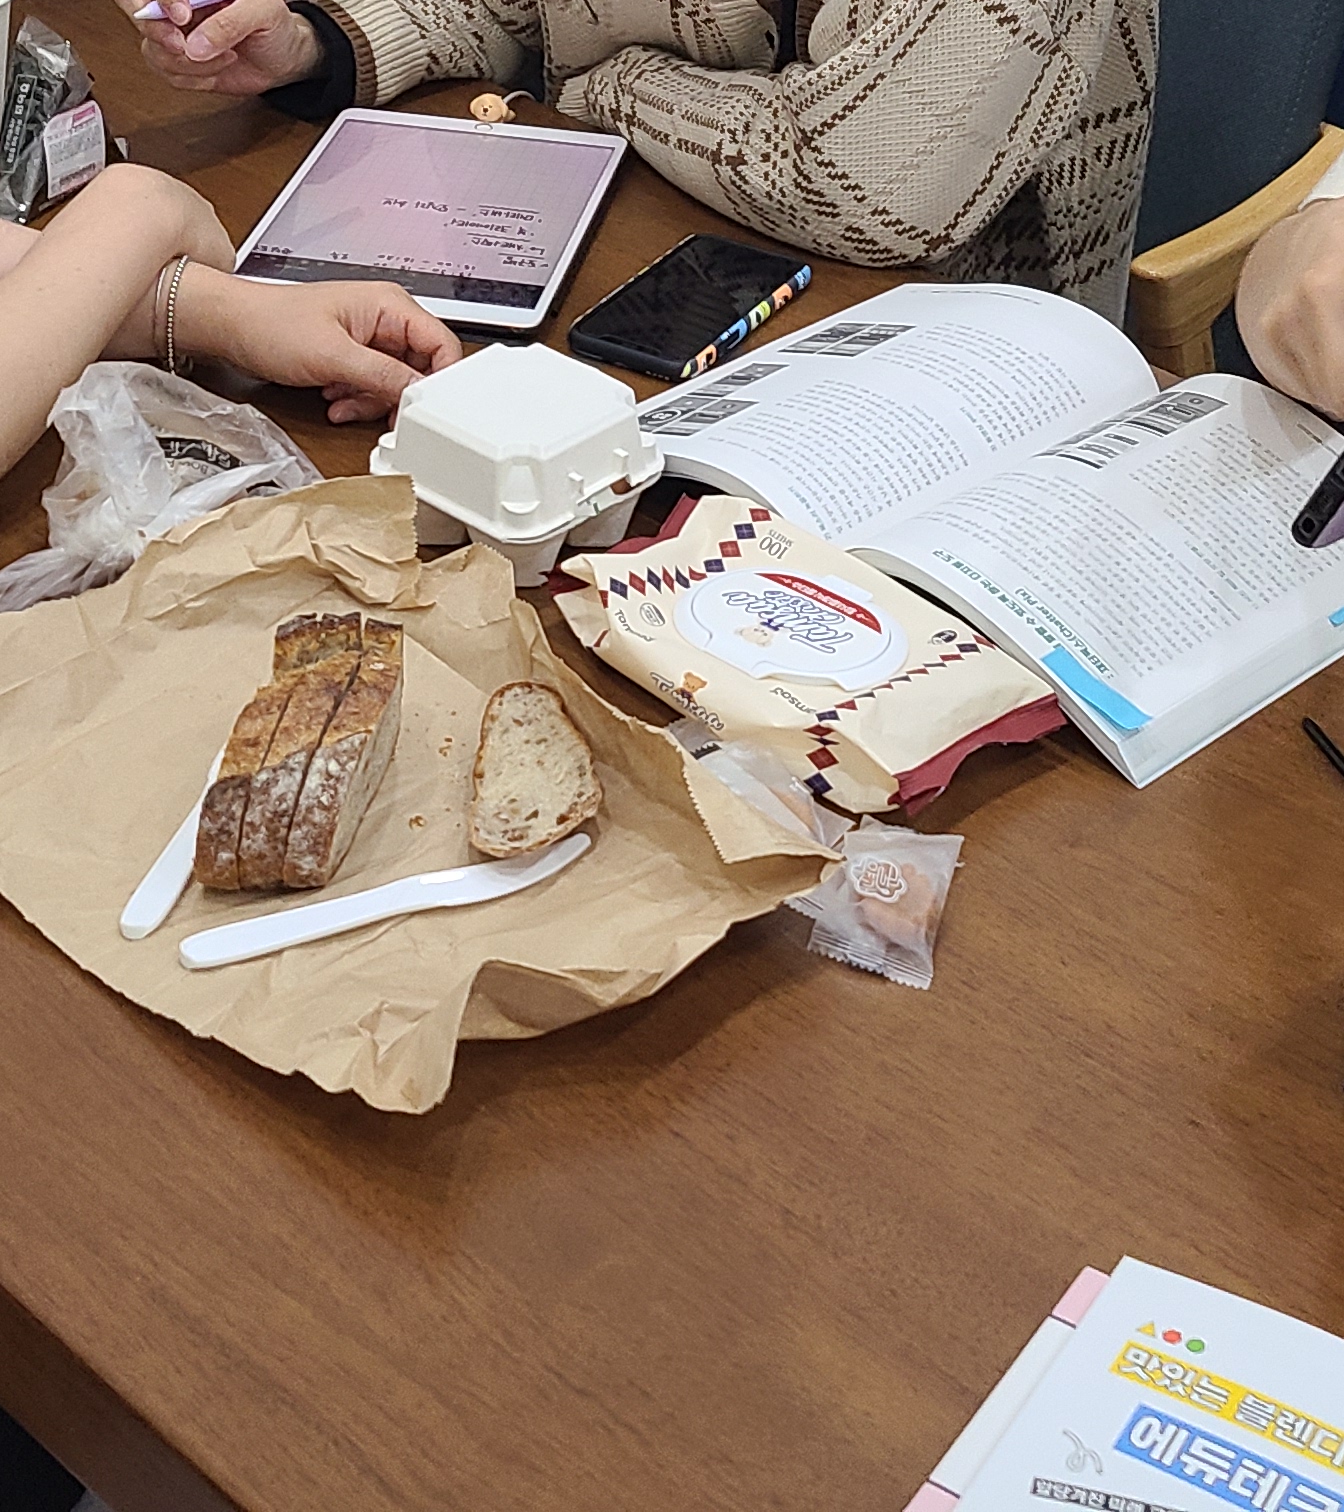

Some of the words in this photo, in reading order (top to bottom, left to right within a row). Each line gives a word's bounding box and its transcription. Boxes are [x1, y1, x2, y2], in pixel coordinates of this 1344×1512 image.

[759, 536, 789, 560] 100
[932, 549, 954, 563] 도구
[1118, 1345, 1230, 1413] 맛있는
[1128, 1415, 1343, 1512] 에듀테크
